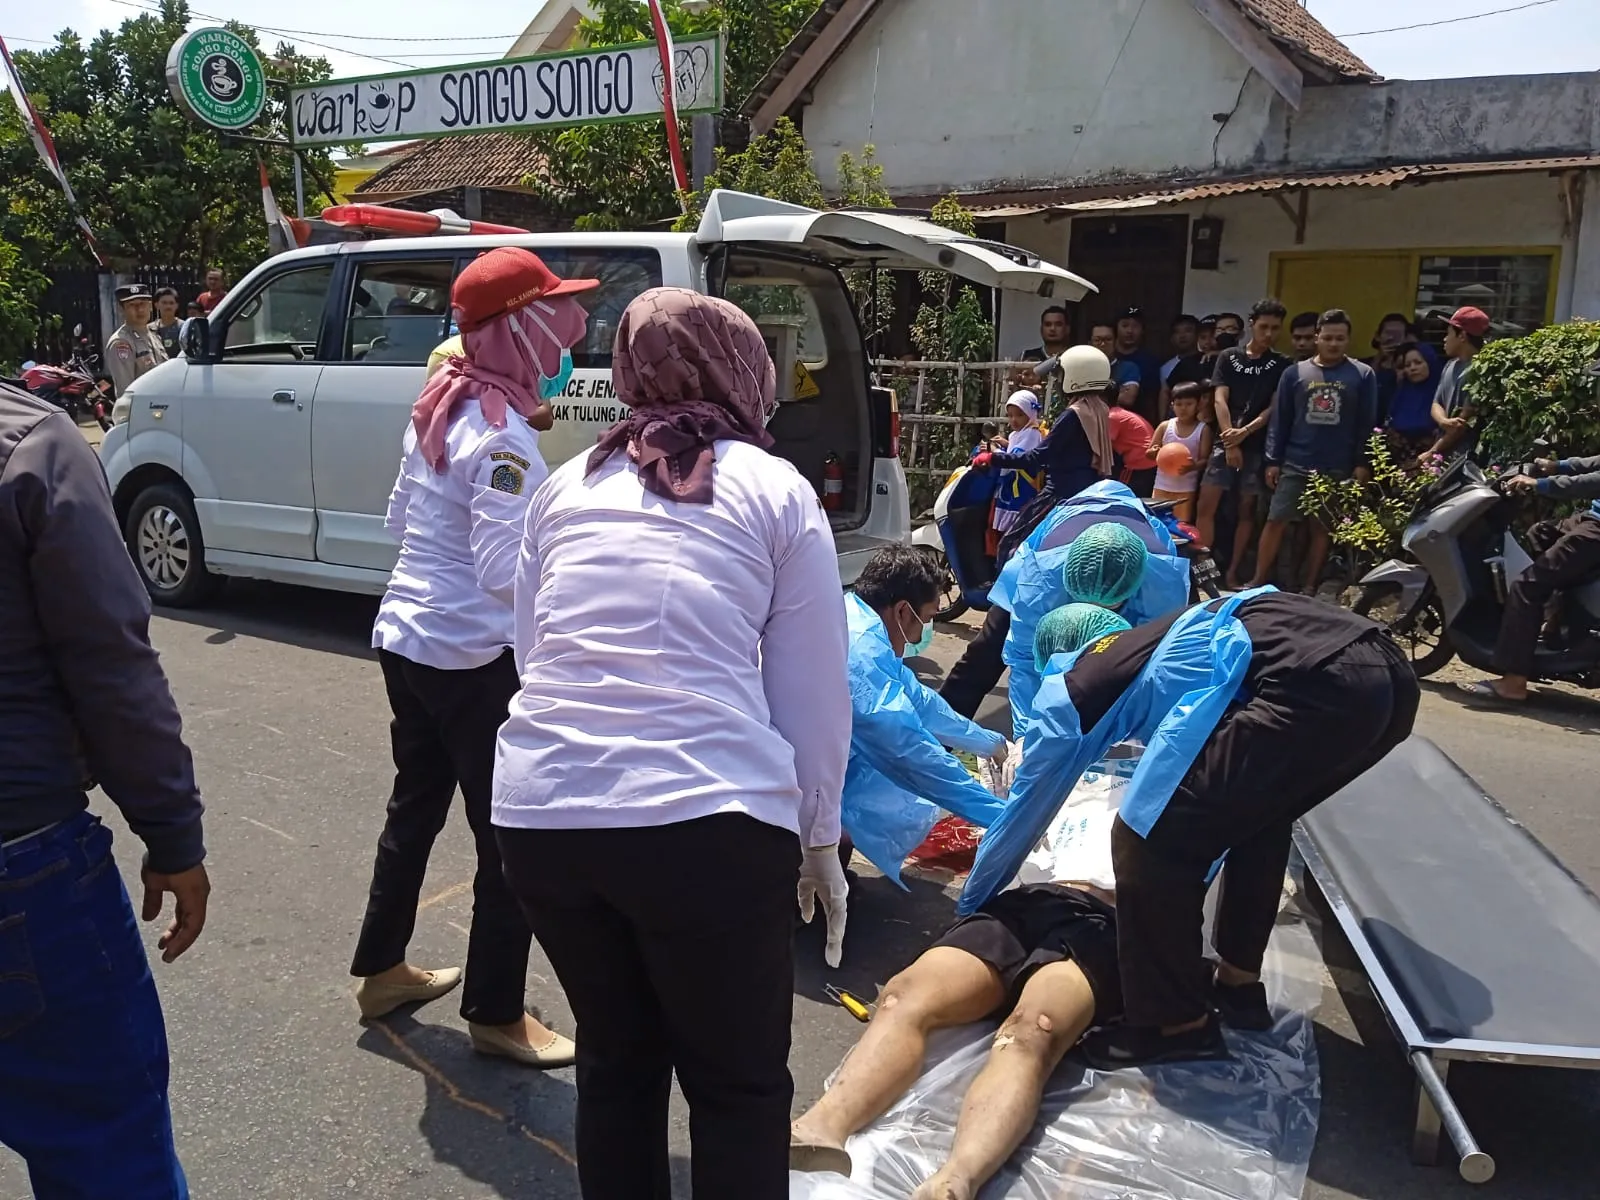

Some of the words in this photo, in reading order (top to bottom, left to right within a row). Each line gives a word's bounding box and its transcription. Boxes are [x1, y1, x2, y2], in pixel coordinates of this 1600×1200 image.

[197, 33, 247, 53] WARKOP
[191, 43, 220, 72] SONGO
[223, 45, 253, 83] SONGO
[439, 64, 528, 127] SONGO
[534, 52, 633, 120] SONGO
[573, 405, 616, 422] TULUNG
